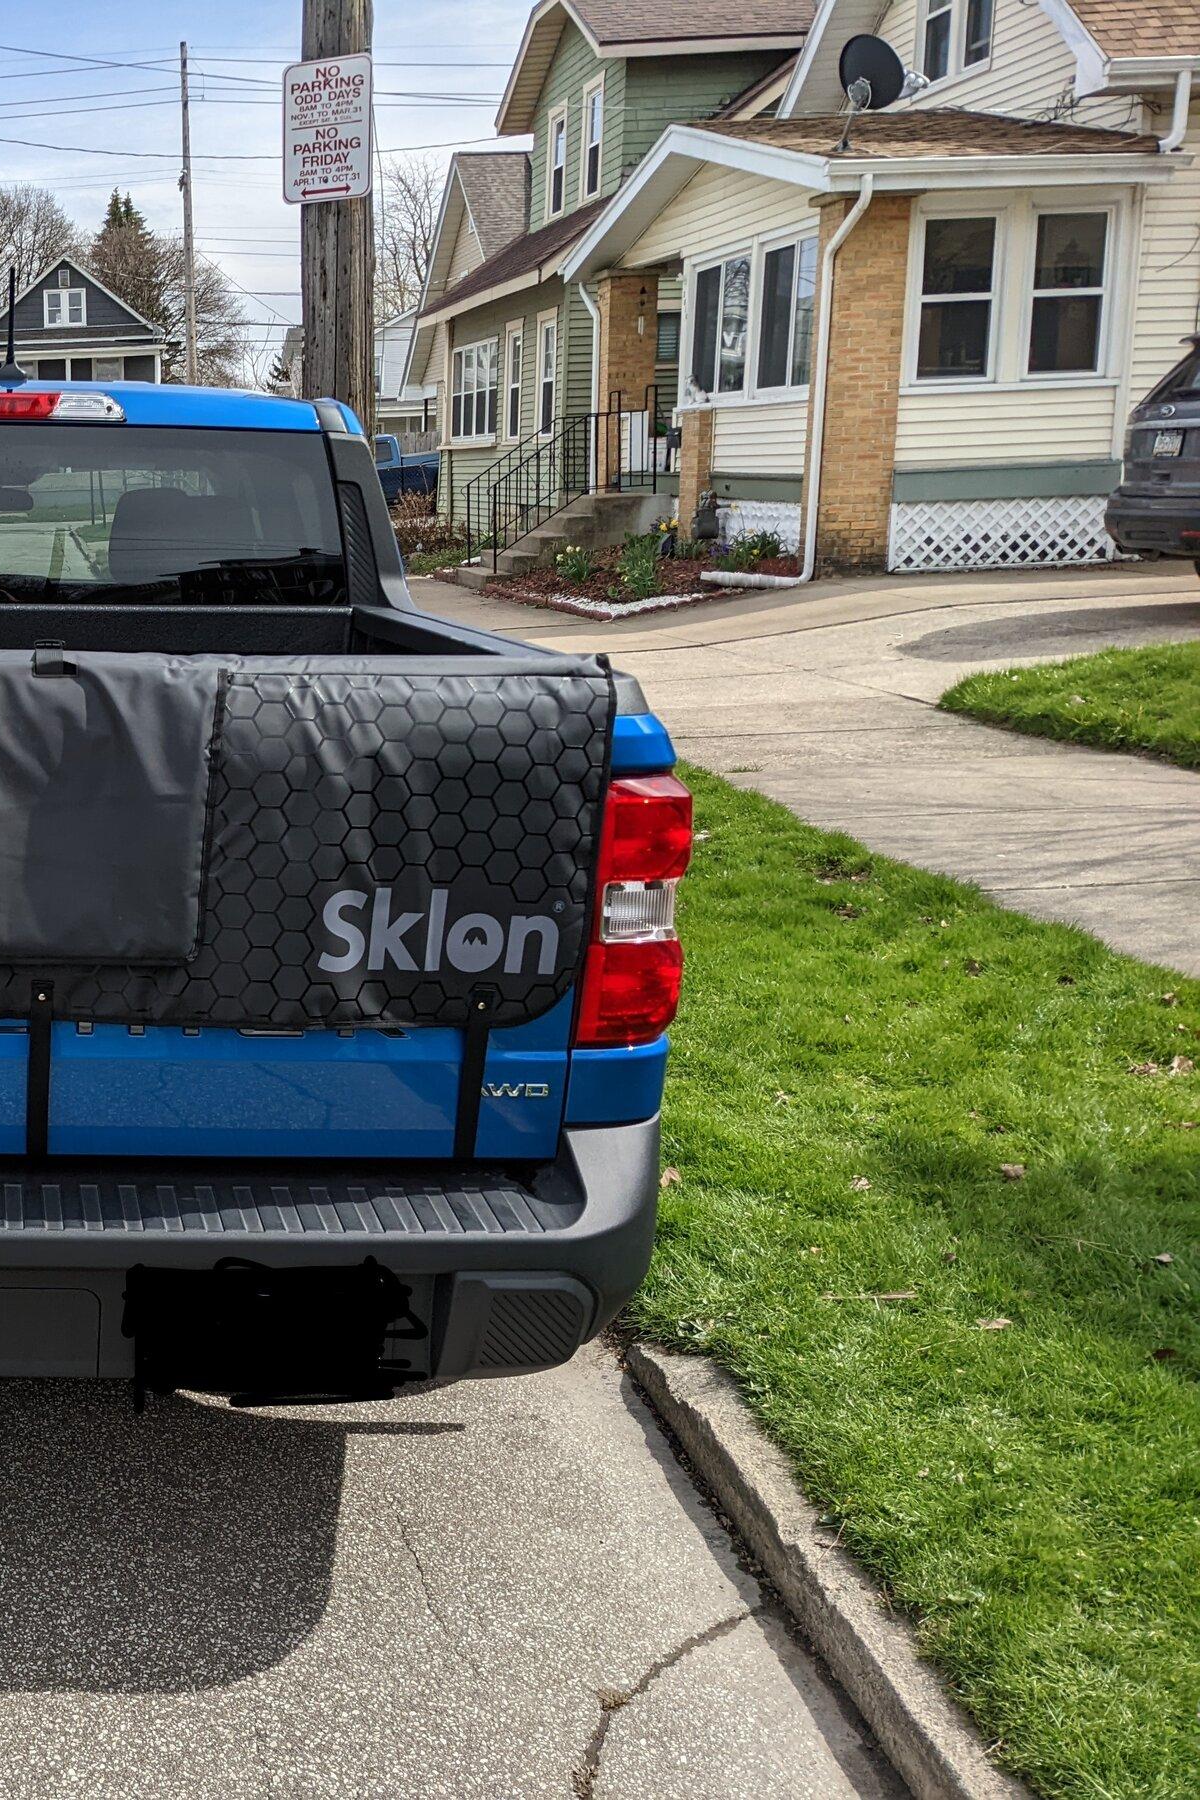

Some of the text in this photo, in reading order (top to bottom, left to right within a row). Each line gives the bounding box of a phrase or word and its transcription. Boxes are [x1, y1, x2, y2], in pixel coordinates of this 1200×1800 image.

[316, 65, 340, 79] NO
[291, 74, 364, 95] PARKING
[295, 87, 360, 105] ODD DAYS
[316, 127, 338, 140] NO
[293, 136, 361, 155] PARKING
[302, 151, 350, 168] FRIDAY
[299, 169, 317, 177] 8AM
[318, 176, 328, 184] TO
[317, 887, 559, 975] Sklon
